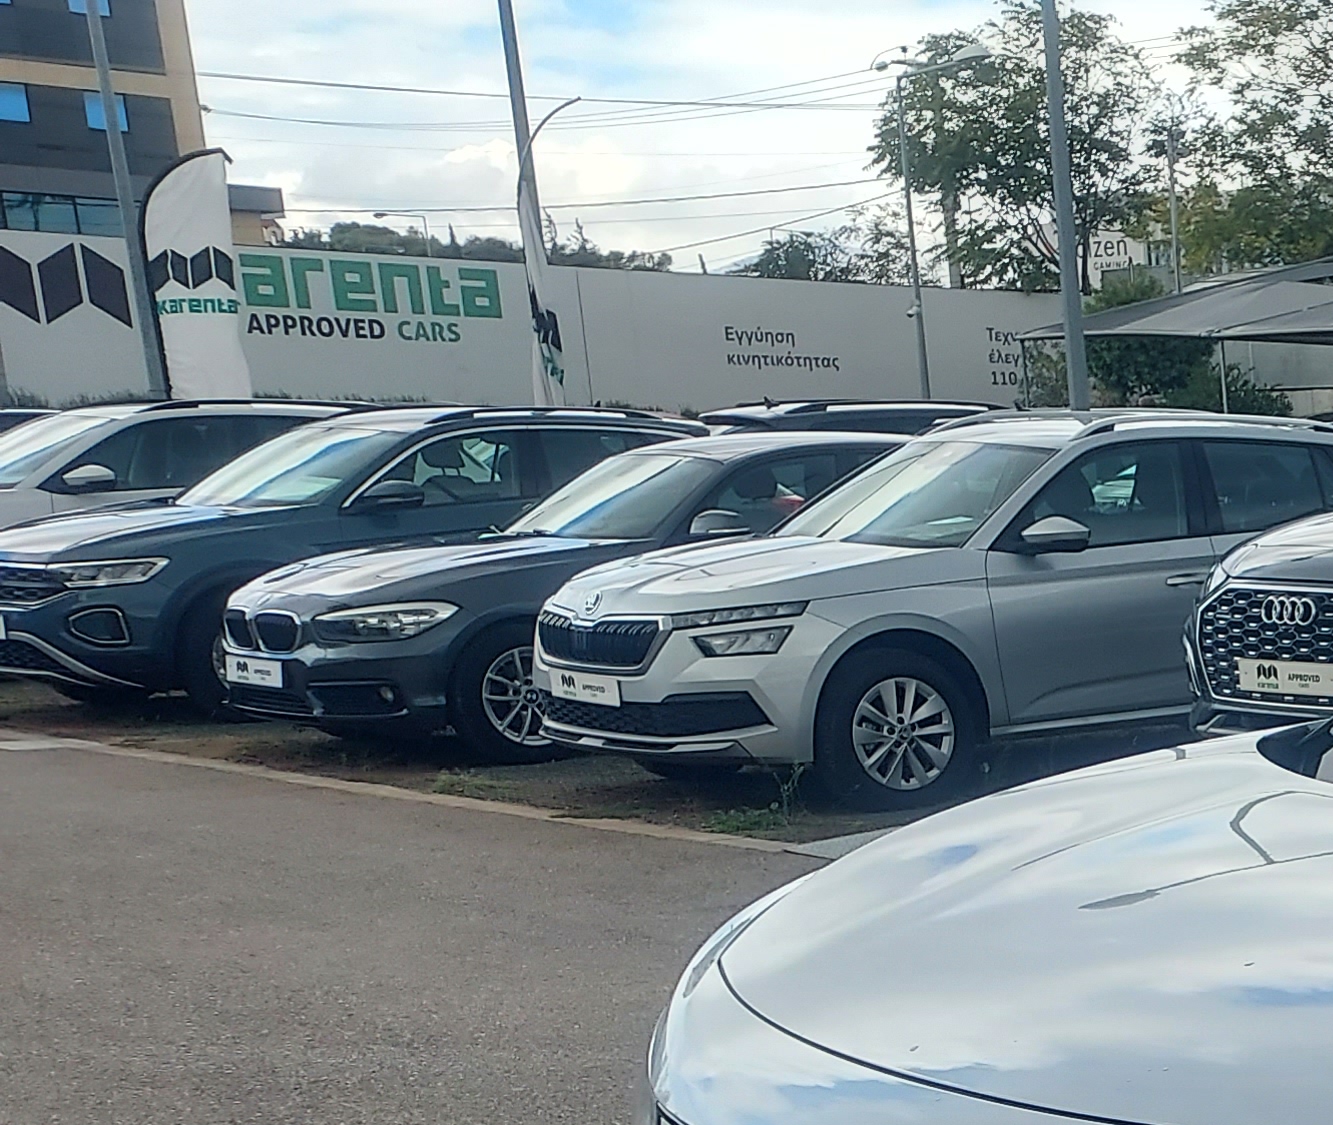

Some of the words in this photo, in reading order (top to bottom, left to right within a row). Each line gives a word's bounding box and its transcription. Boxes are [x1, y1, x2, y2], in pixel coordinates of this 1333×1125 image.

[238, 253, 503, 319] arenta
[247, 313, 386, 340] APPROVED
[397, 320, 461, 342] CARS
[724, 326, 795, 347] Εγγύηση
[727, 351, 839, 371] κινητικότητας
